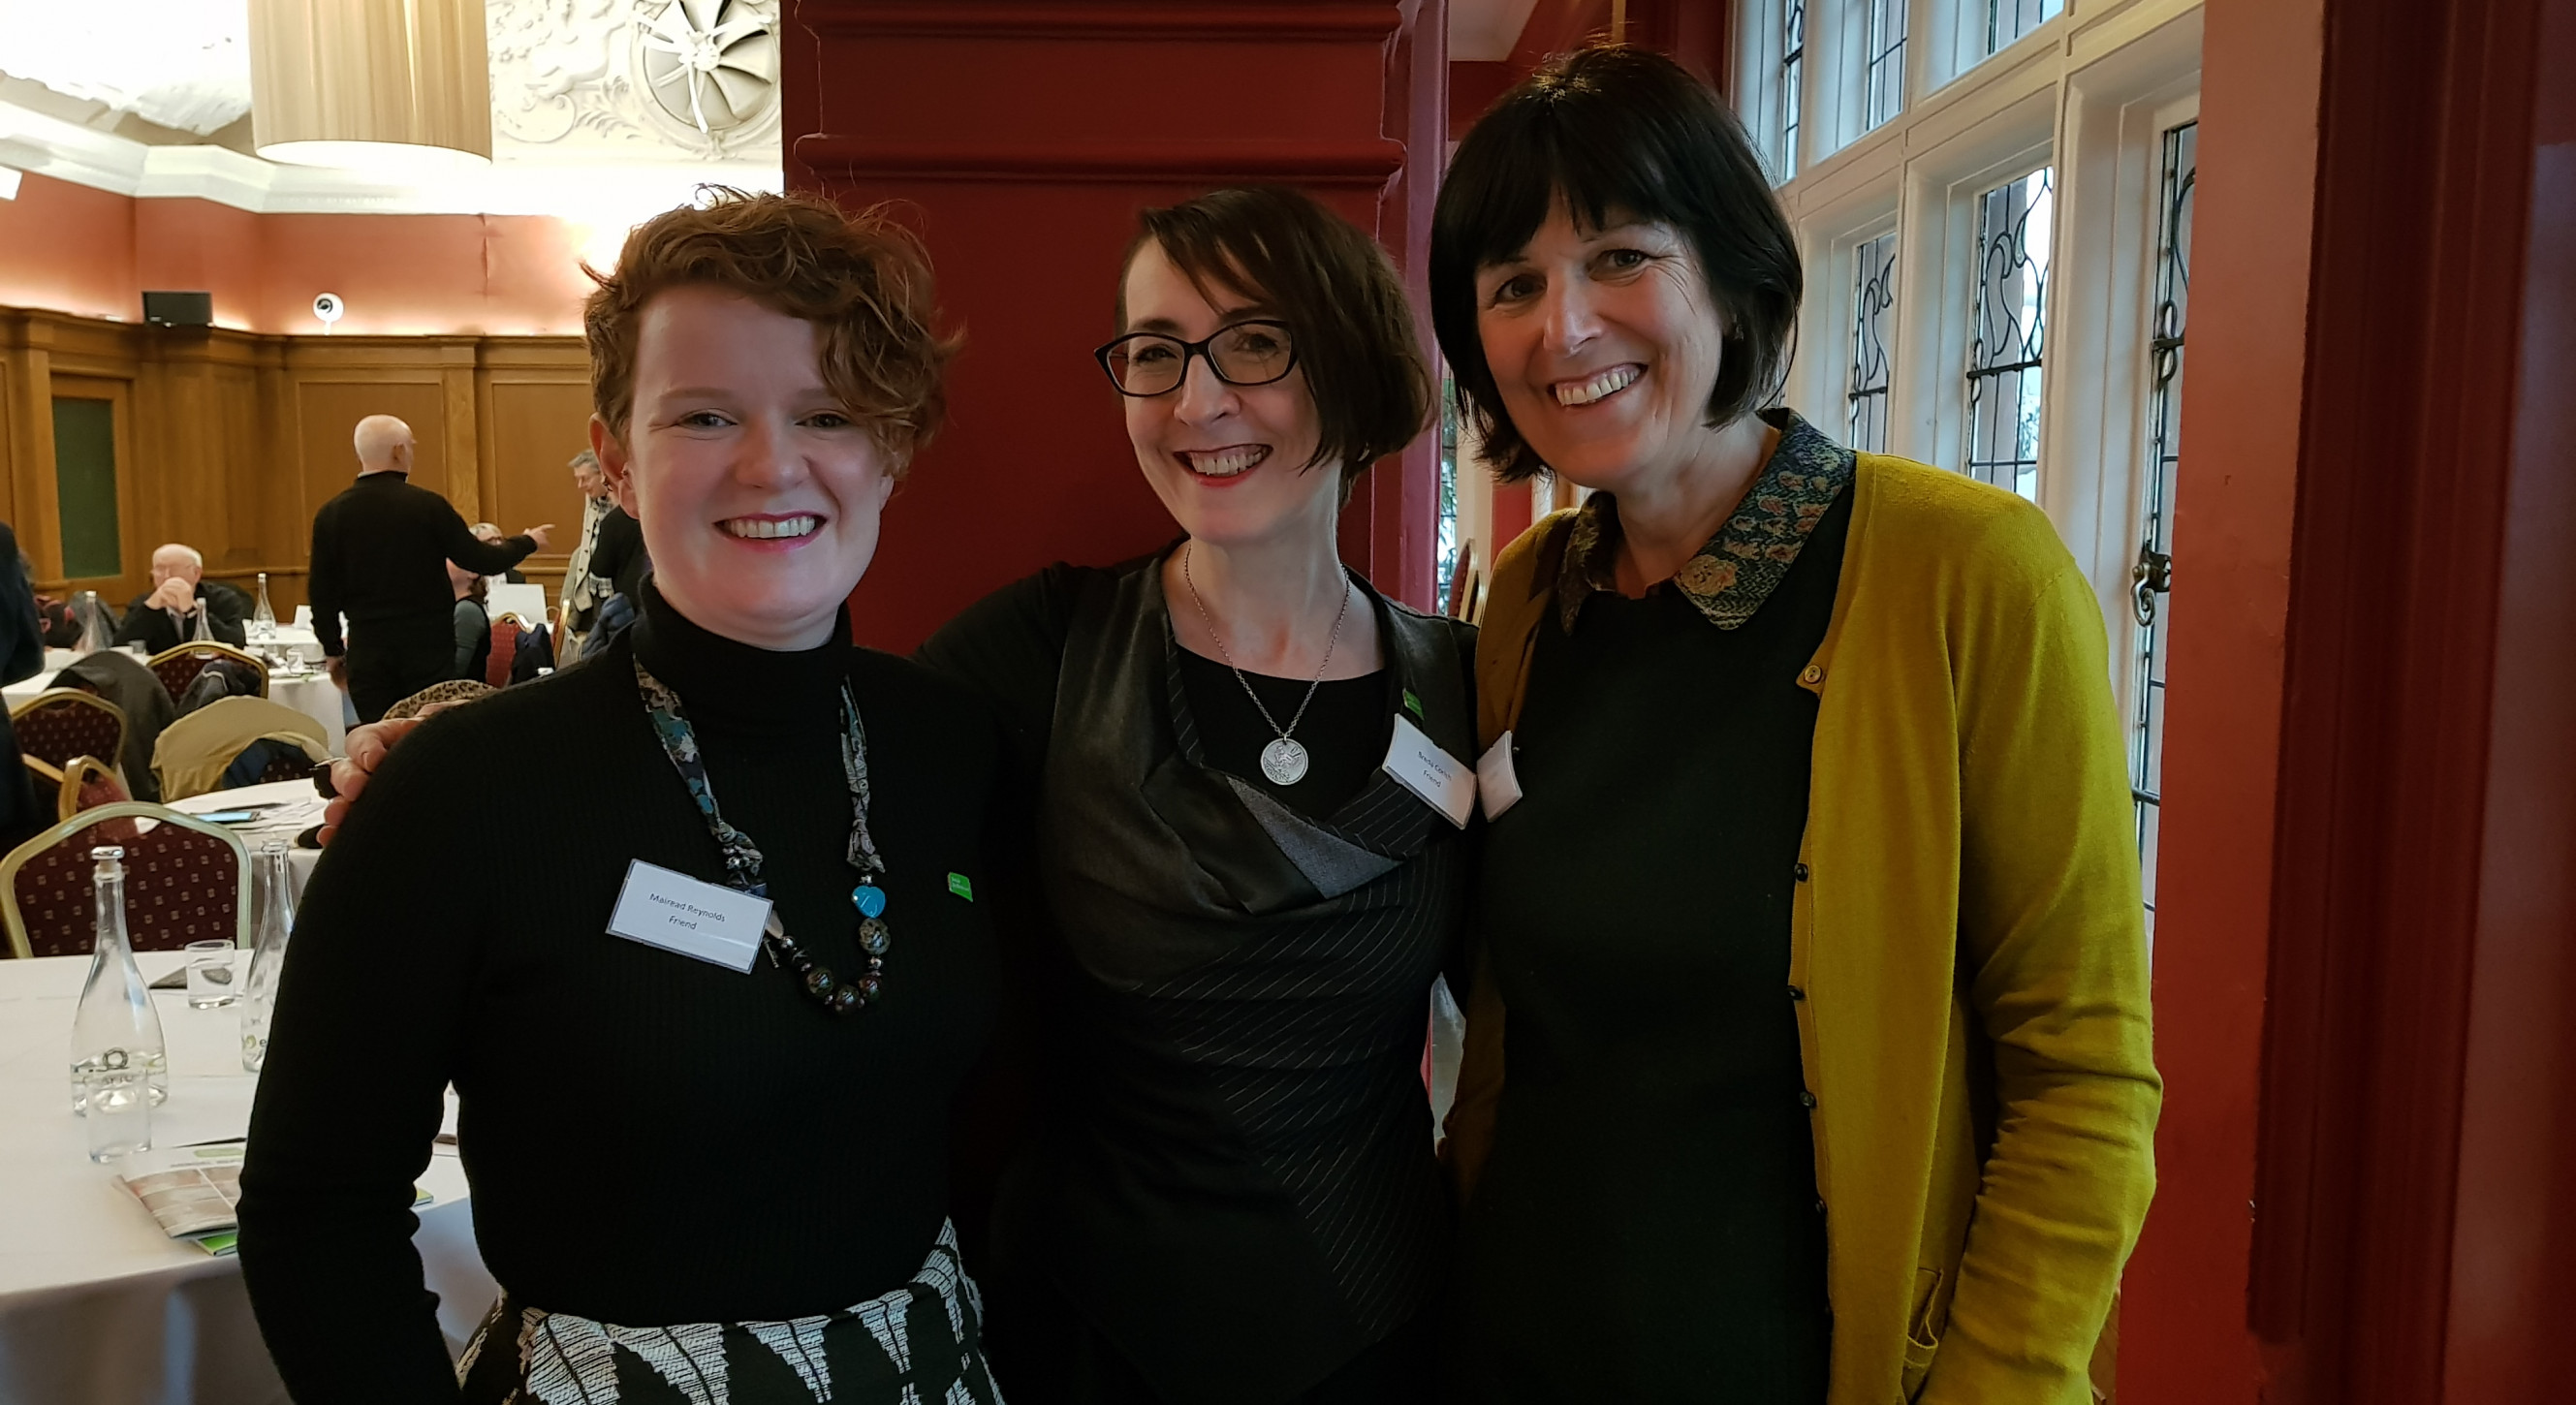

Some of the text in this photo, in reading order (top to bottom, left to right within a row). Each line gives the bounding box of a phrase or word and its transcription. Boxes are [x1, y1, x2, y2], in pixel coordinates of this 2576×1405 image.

[1424, 769, 1441, 788] Friend
[649, 892, 725, 922] Mairead Reynolds
[669, 915, 698, 930] Friend
